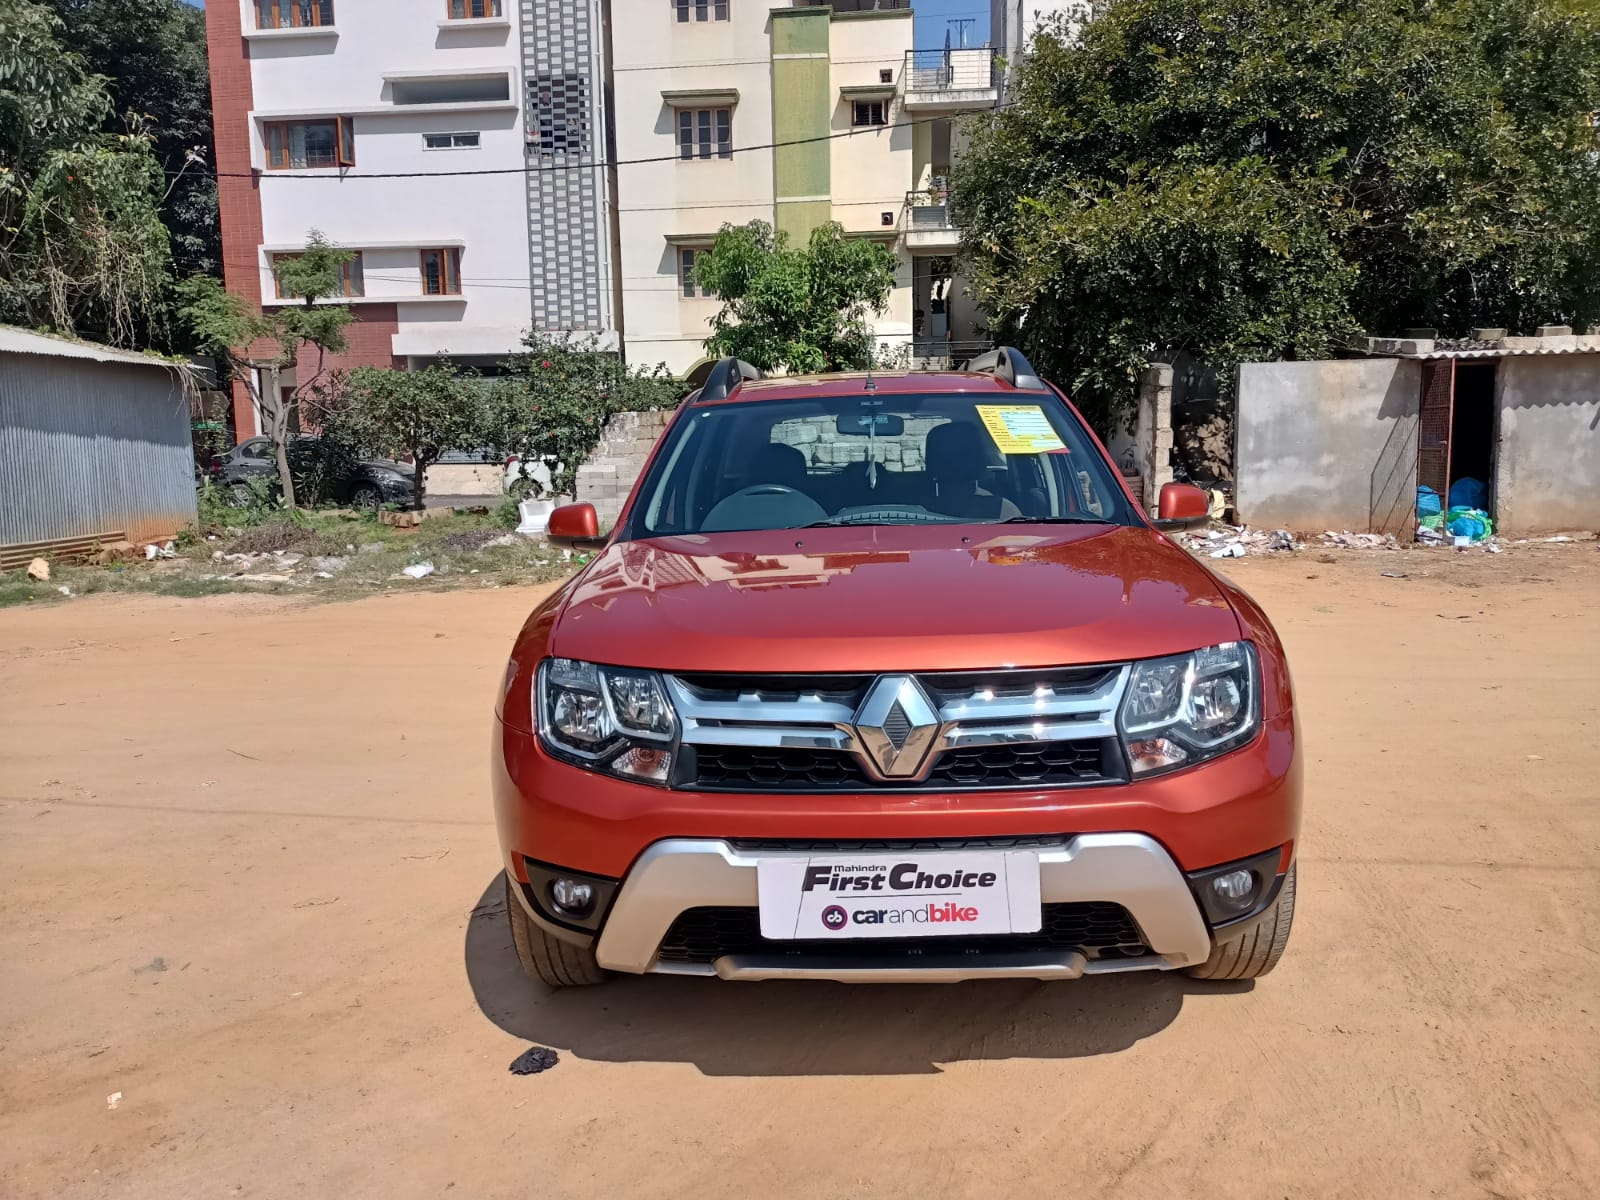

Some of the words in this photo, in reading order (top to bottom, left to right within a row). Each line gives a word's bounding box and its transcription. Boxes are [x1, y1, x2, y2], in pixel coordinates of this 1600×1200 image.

[802, 866, 886, 891] First
[888, 863, 996, 890] Choice
[834, 864, 887, 872] Mahindra
[852, 903, 979, 924] carandbike
